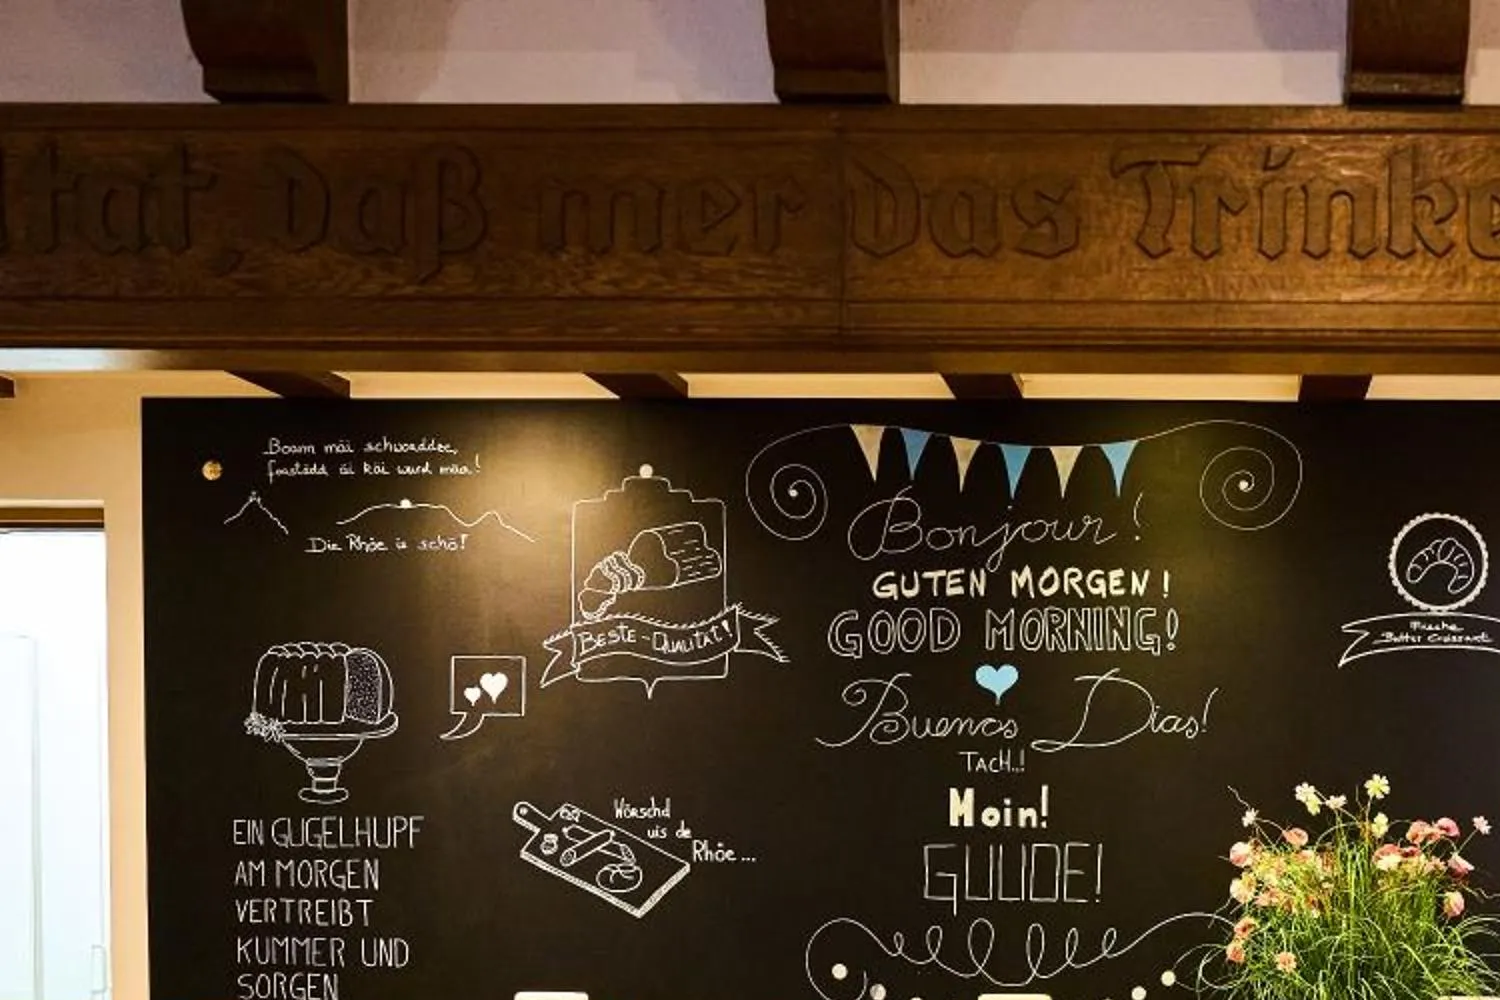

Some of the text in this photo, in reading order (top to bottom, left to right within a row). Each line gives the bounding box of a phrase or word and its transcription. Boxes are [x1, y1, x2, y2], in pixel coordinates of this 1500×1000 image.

[304, 536, 342, 552] Die
[872, 567, 987, 601] GUTEN
[828, 606, 1180, 659] GOOD MORNING!
[814, 667, 1220, 753] Buenos Dias!
[949, 784, 1049, 829] Moin!
[233, 815, 425, 850] EIN GUGELHUPF
[647, 818, 693, 840] uis de
[235, 859, 380, 891] AM MORGEN
[923, 842, 1103, 918] GUUDE!
[235, 898, 374, 928] VERTREIBT
[236, 936, 410, 969] KUMMER UND
